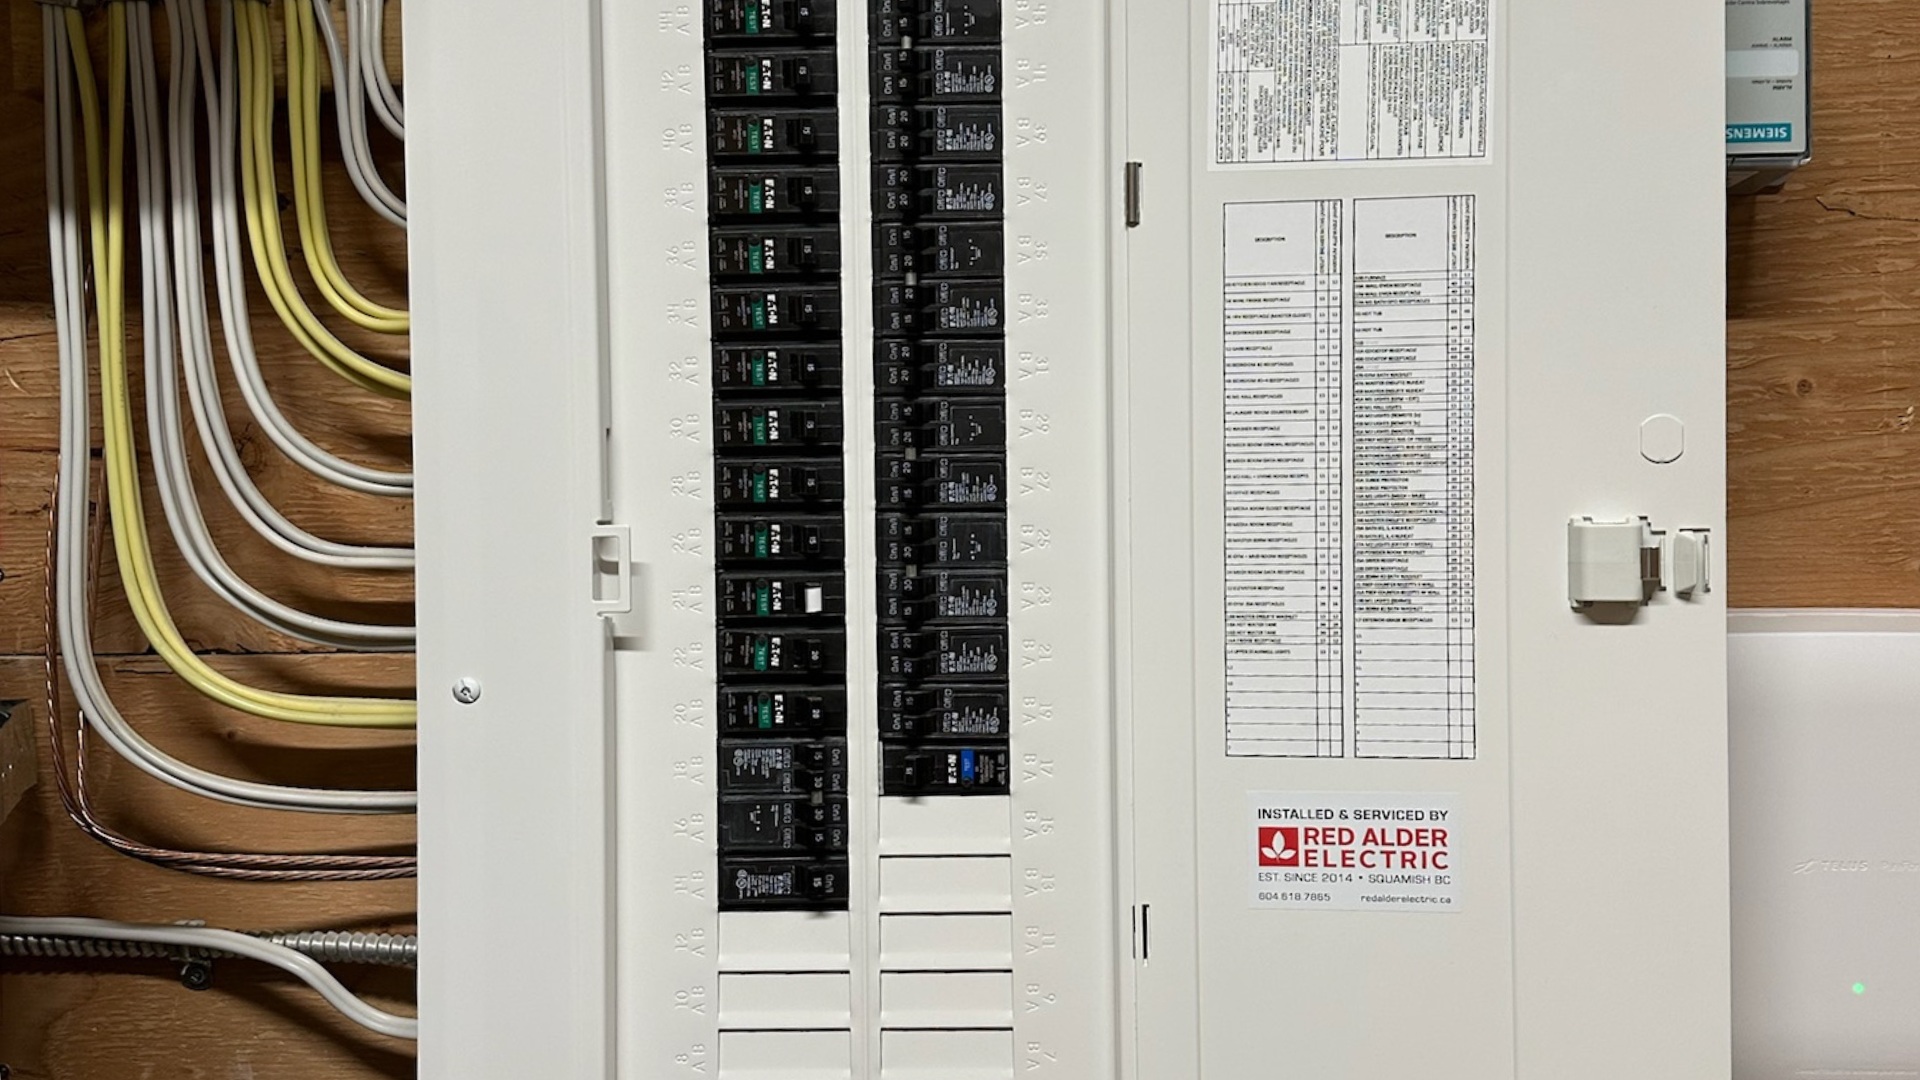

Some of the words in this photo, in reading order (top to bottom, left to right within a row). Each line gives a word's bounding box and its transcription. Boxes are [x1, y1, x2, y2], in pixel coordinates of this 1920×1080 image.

[659, 11, 674, 33] 44
[1032, 3, 1046, 27] 43
[660, 70, 675, 92] 42
[1032, 62, 1047, 83] 41
[662, 127, 677, 151] 40
[1032, 122, 1047, 144] 39
[1726, 127, 1787, 139] SIEMENS
[664, 186, 678, 208] 38
[1033, 181, 1048, 202] 37
[665, 245, 680, 267] 36
[1033, 240, 1048, 261] 35
[667, 303, 682, 324] 34
[1034, 298, 1049, 319] 33
[668, 361, 683, 382] 32
[1035, 356, 1050, 376] 31
[669, 417, 685, 439] 30
[1035, 414, 1051, 434] 29
[670, 475, 686, 497] 28
[1036, 472, 1051, 492] 27
[671, 533, 686, 554] 26
[1037, 529, 1052, 549] 25
[671, 589, 687, 611] 24
[1037, 587, 1052, 606] 23
[672, 646, 688, 668] 22
[1038, 644, 1053, 663] 21
[672, 704, 688, 725] 20
[1039, 702, 1054, 720] 19
[673, 760, 688, 780] 18
[1039, 759, 1054, 778] 17
[1258, 808, 1334, 820] INSTALLED
[1339, 809, 1348, 820] &
[1353, 809, 1424, 821] SERVICED
[1429, 810, 1448, 821] BY
[673, 817, 689, 837] 16
[1040, 817, 1055, 835] 15
[1304, 827, 1355, 846] RED
[1362, 828, 1448, 847] ALDER
[1304, 849, 1448, 869] ELECTRIC
[674, 875, 689, 895] 14
[1041, 874, 1056, 892] 13
[1284, 873, 1317, 882] SINCE
[1321, 873, 1353, 883] 2014
[1368, 874, 1431, 884] SQUAMISH
[1434, 875, 1451, 885] BC
[674, 933, 689, 953] 12
[1041, 932, 1056, 949] 11
[674, 990, 689, 1010] 10
[1042, 992, 1057, 1005] 9
[675, 1053, 690, 1065] 8
[1043, 1051, 1058, 1063] 7
